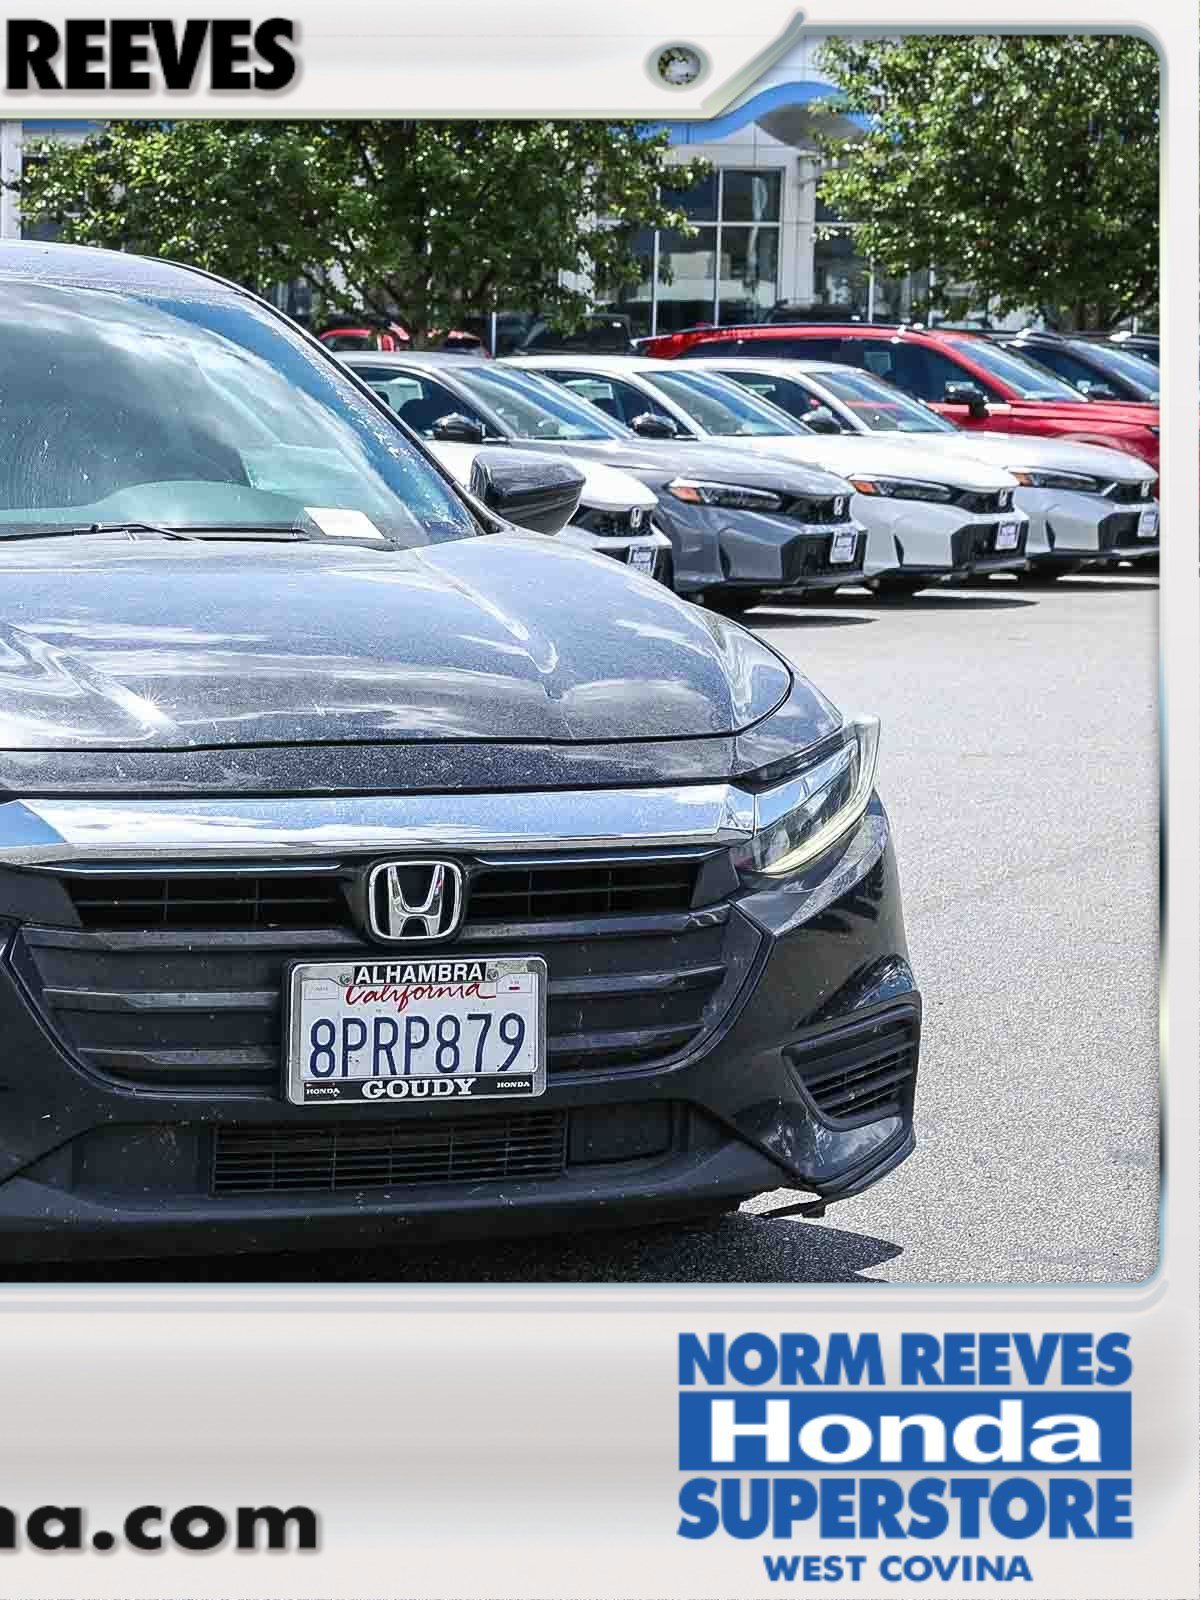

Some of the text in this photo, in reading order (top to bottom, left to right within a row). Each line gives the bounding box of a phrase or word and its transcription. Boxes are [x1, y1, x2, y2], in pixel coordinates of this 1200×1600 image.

[355, 963, 483, 985] ALHAMBRA
[345, 980, 497, 1013] California
[309, 1012, 526, 1078] 8PRP879
[306, 1087, 341, 1096] HONDA
[362, 1077, 477, 1099] GOUDY
[496, 1080, 531, 1089] HONDA
